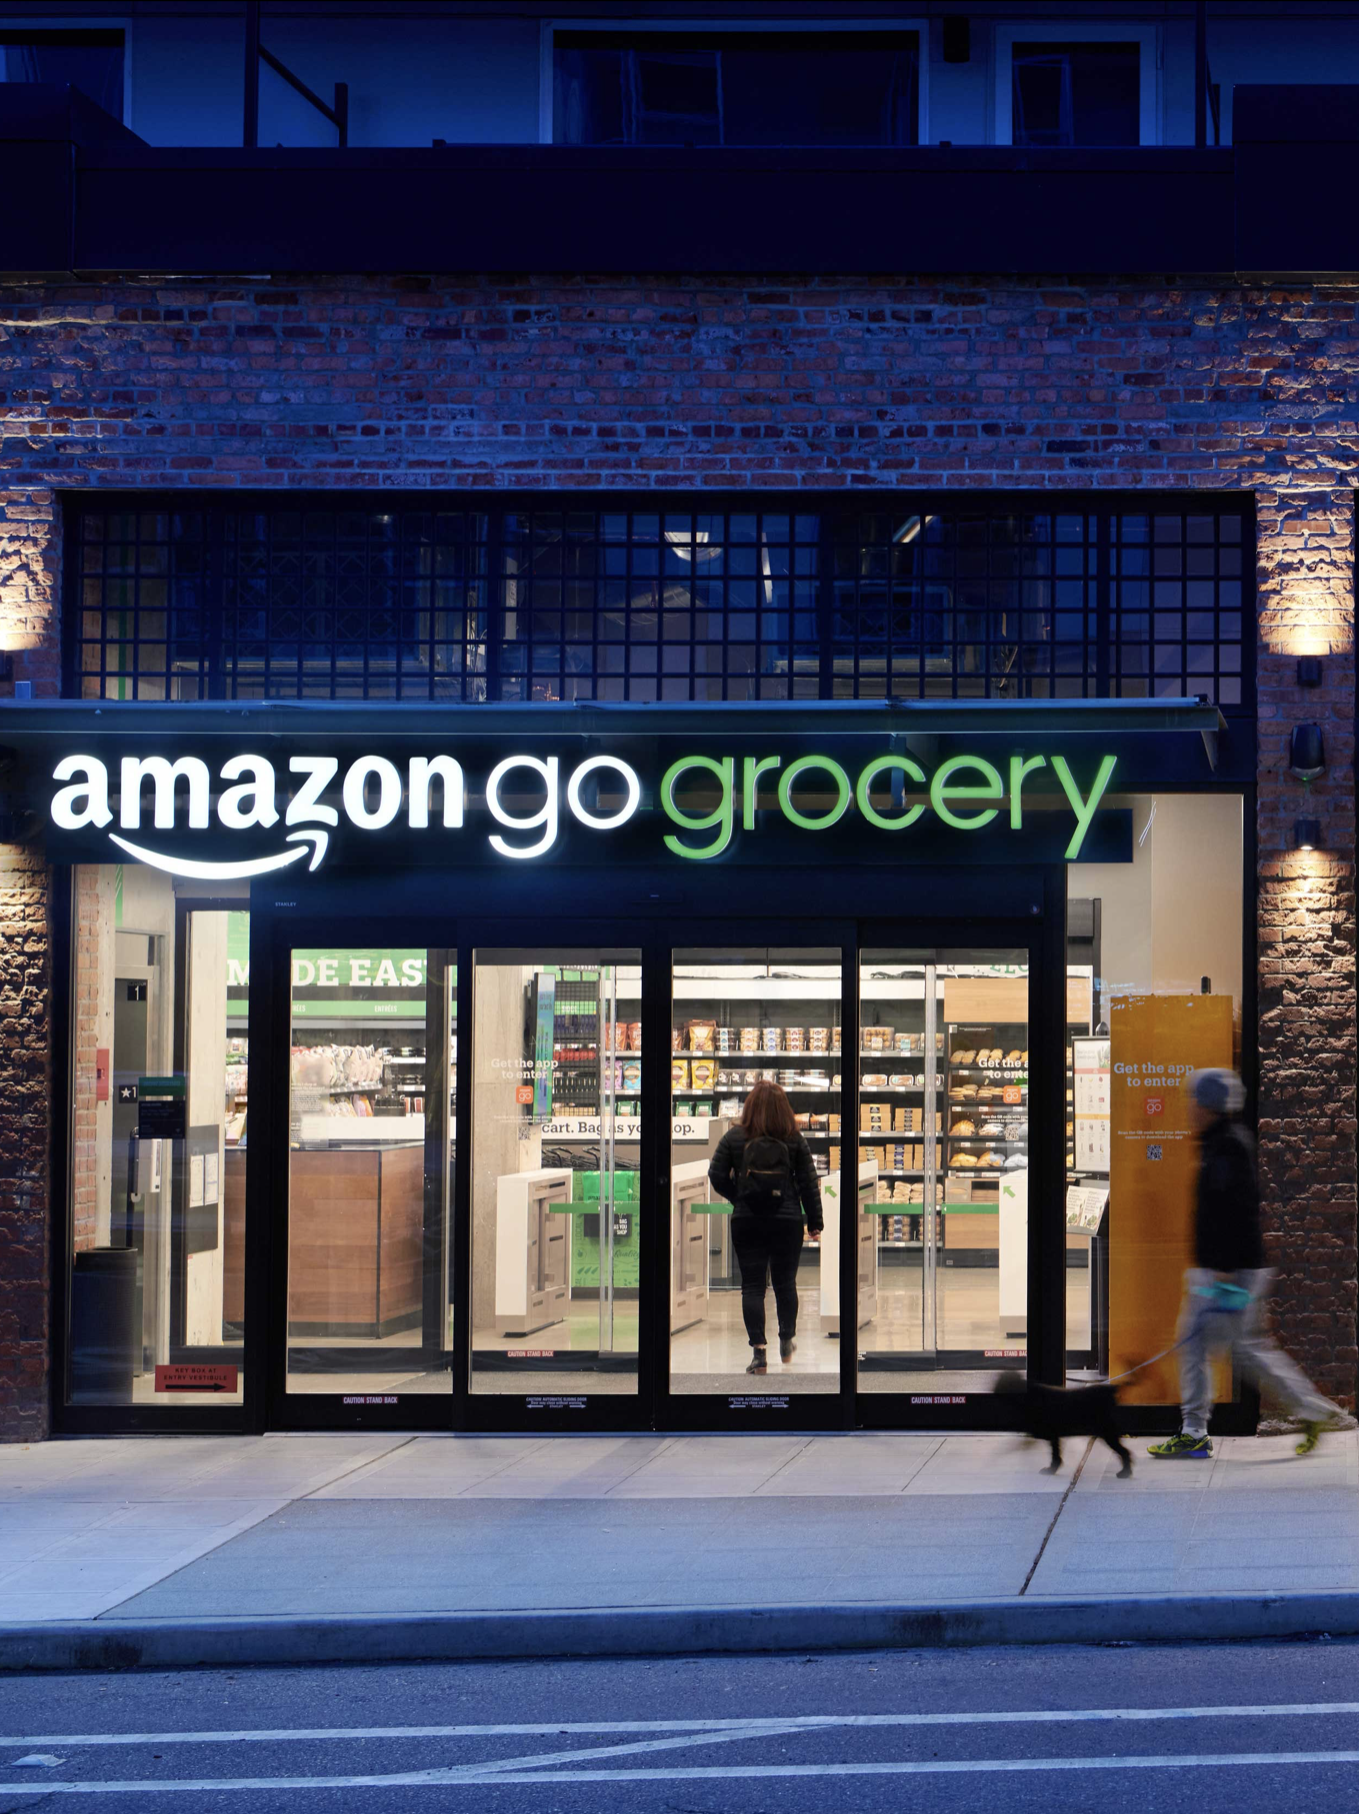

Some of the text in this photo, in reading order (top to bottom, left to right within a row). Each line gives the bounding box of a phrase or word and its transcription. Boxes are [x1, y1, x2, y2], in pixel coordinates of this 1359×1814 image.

[51, 754, 1117, 860] amazon go grocery
[227, 959, 427, 987] MDE EAS
[491, 1058, 559, 1070] Get the app
[978, 1058, 1020, 1068] Get the
[501, 1069, 548, 1079] to enter
[989, 1070, 1029, 1079] to ente
[1113, 1062, 1195, 1076] Get the app
[1126, 1076, 1182, 1087] to enter
[132, 1086, 137, 1098] 1
[518, 1093, 532, 1102] go
[1005, 1092, 1019, 1102] go
[1146, 1103, 1162, 1115] go
[542, 1122, 574, 1134] cart.
[343, 1396, 398, 1404] CAUTION STAND BACK
[911, 1396, 966, 1404] CAUTION STAND BACK
